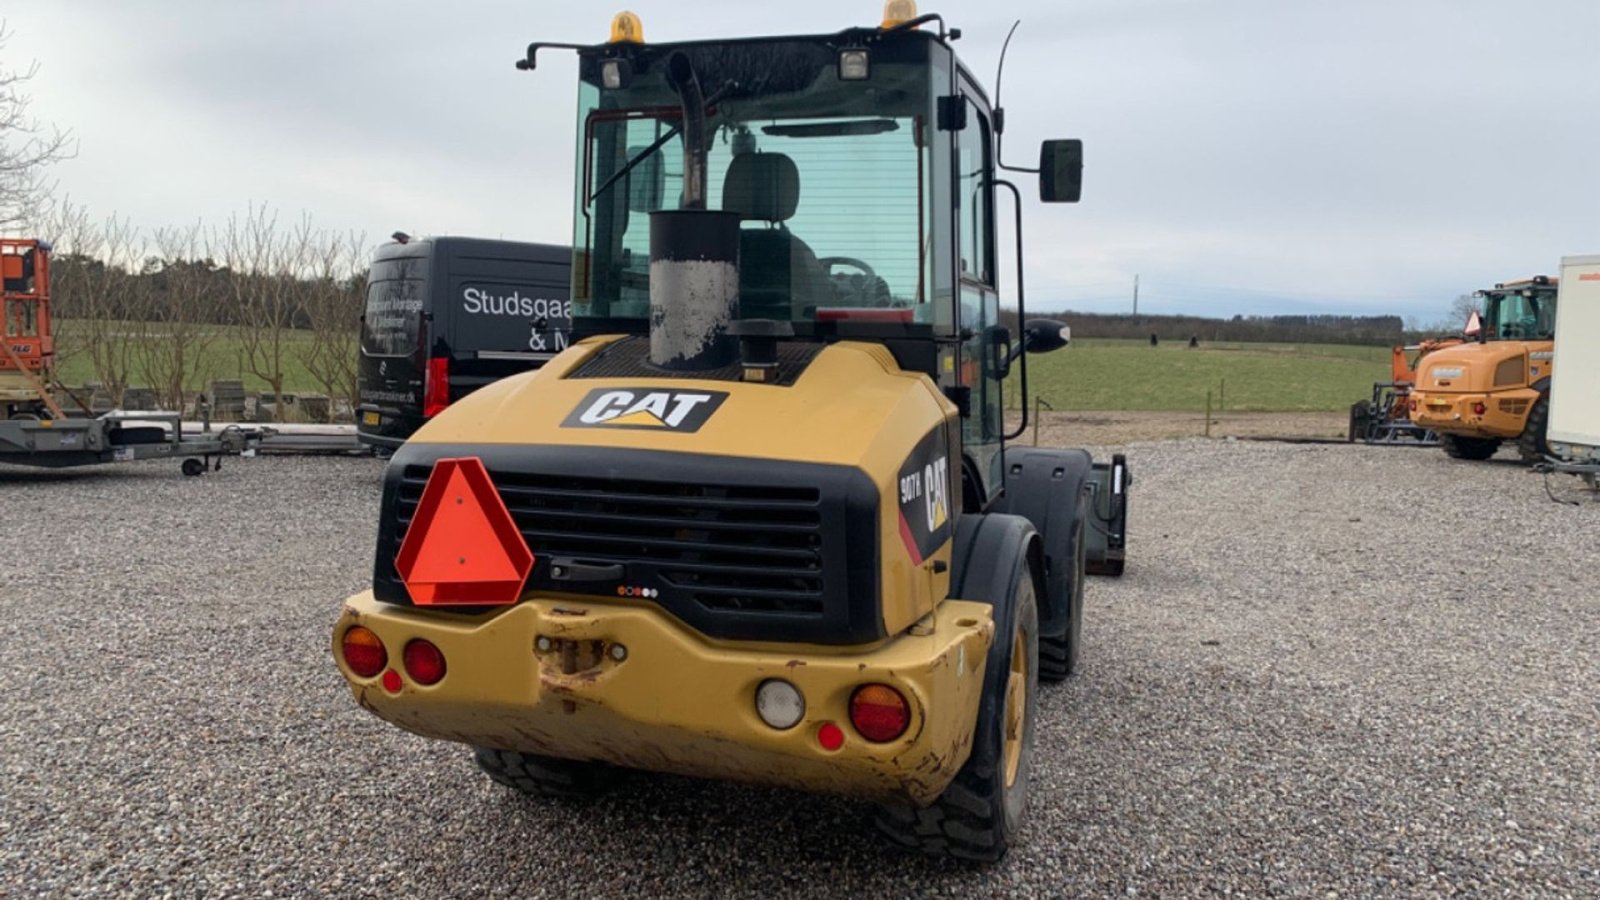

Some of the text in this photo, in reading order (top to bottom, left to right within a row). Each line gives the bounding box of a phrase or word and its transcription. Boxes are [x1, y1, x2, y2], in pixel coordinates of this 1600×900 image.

[528, 327, 547, 351] &
[579, 391, 712, 428] CAT
[924, 456, 948, 533] CAT
